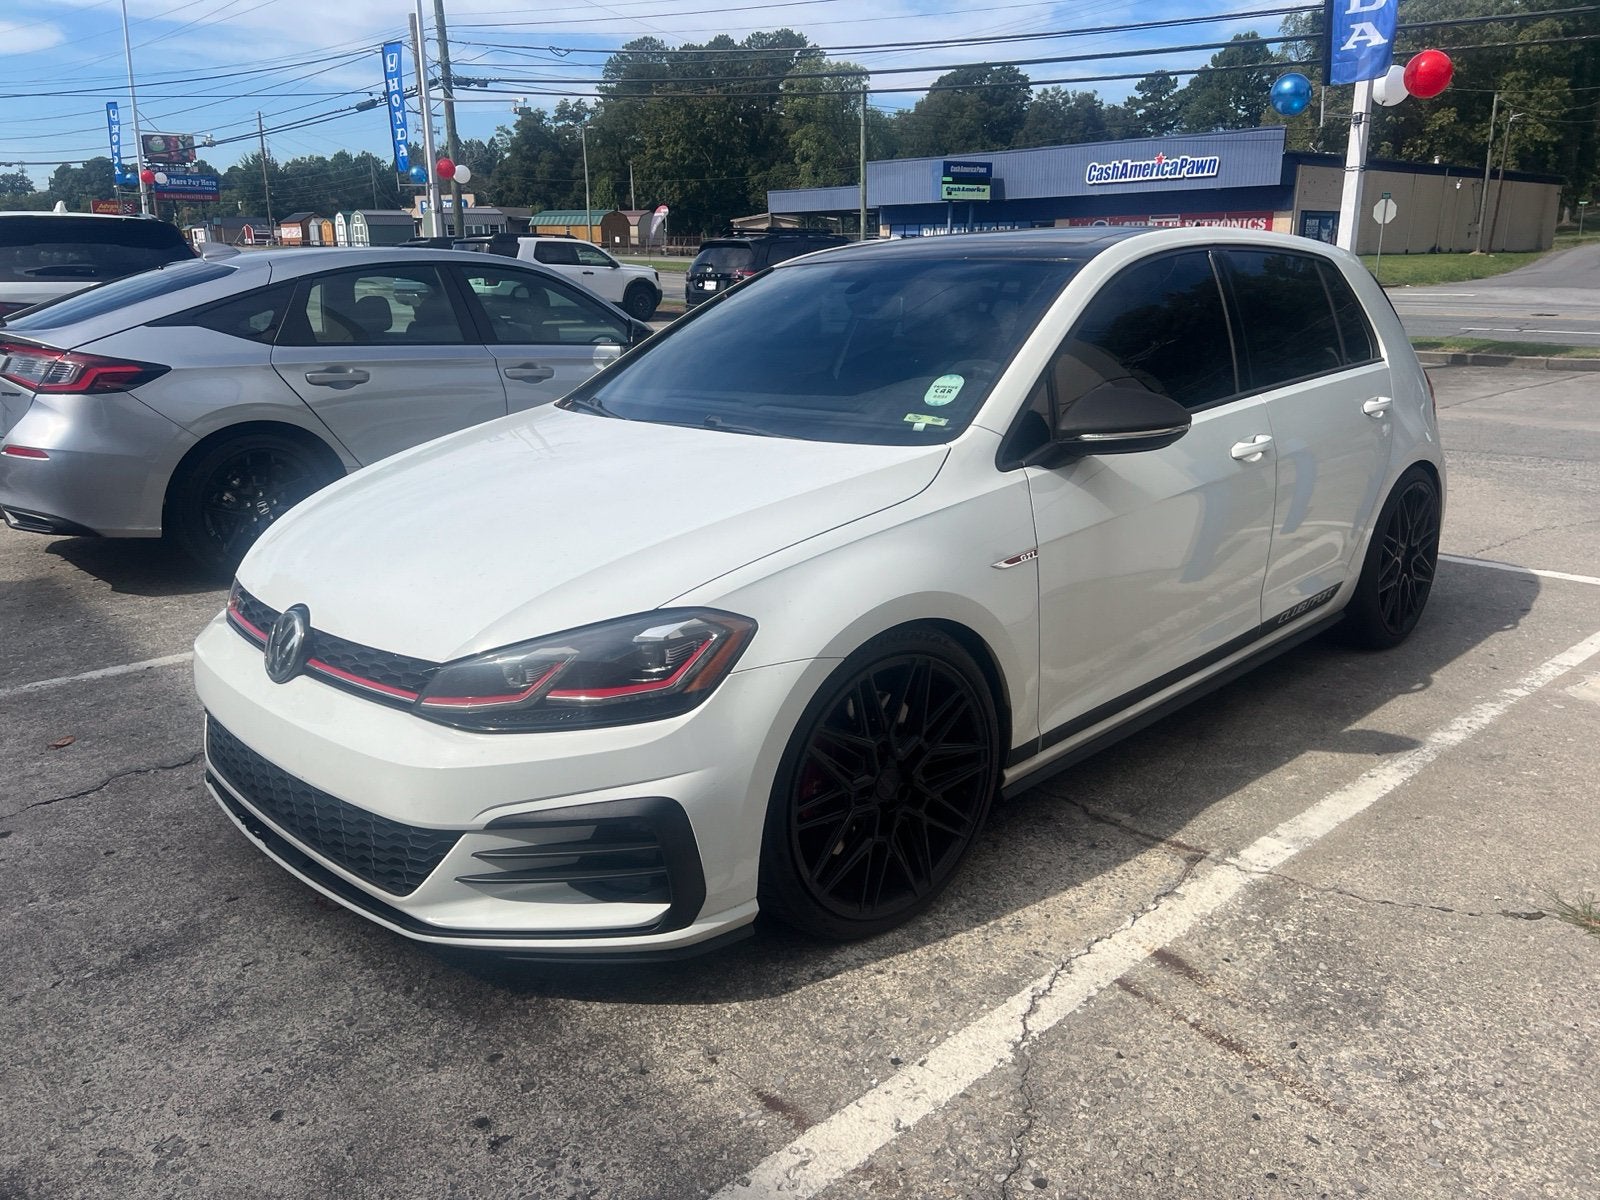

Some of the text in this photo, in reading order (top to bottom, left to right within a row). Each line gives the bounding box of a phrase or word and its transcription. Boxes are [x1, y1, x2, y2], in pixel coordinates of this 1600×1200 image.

[388, 78, 408, 157] HONDA
[111, 124, 122, 175] HONDA
[187, 178, 200, 187] Pay
[200, 179, 217, 187] Here
[1086, 154, 1219, 184] CashAmericaPawn
[1019, 550, 1038, 562] GTI
